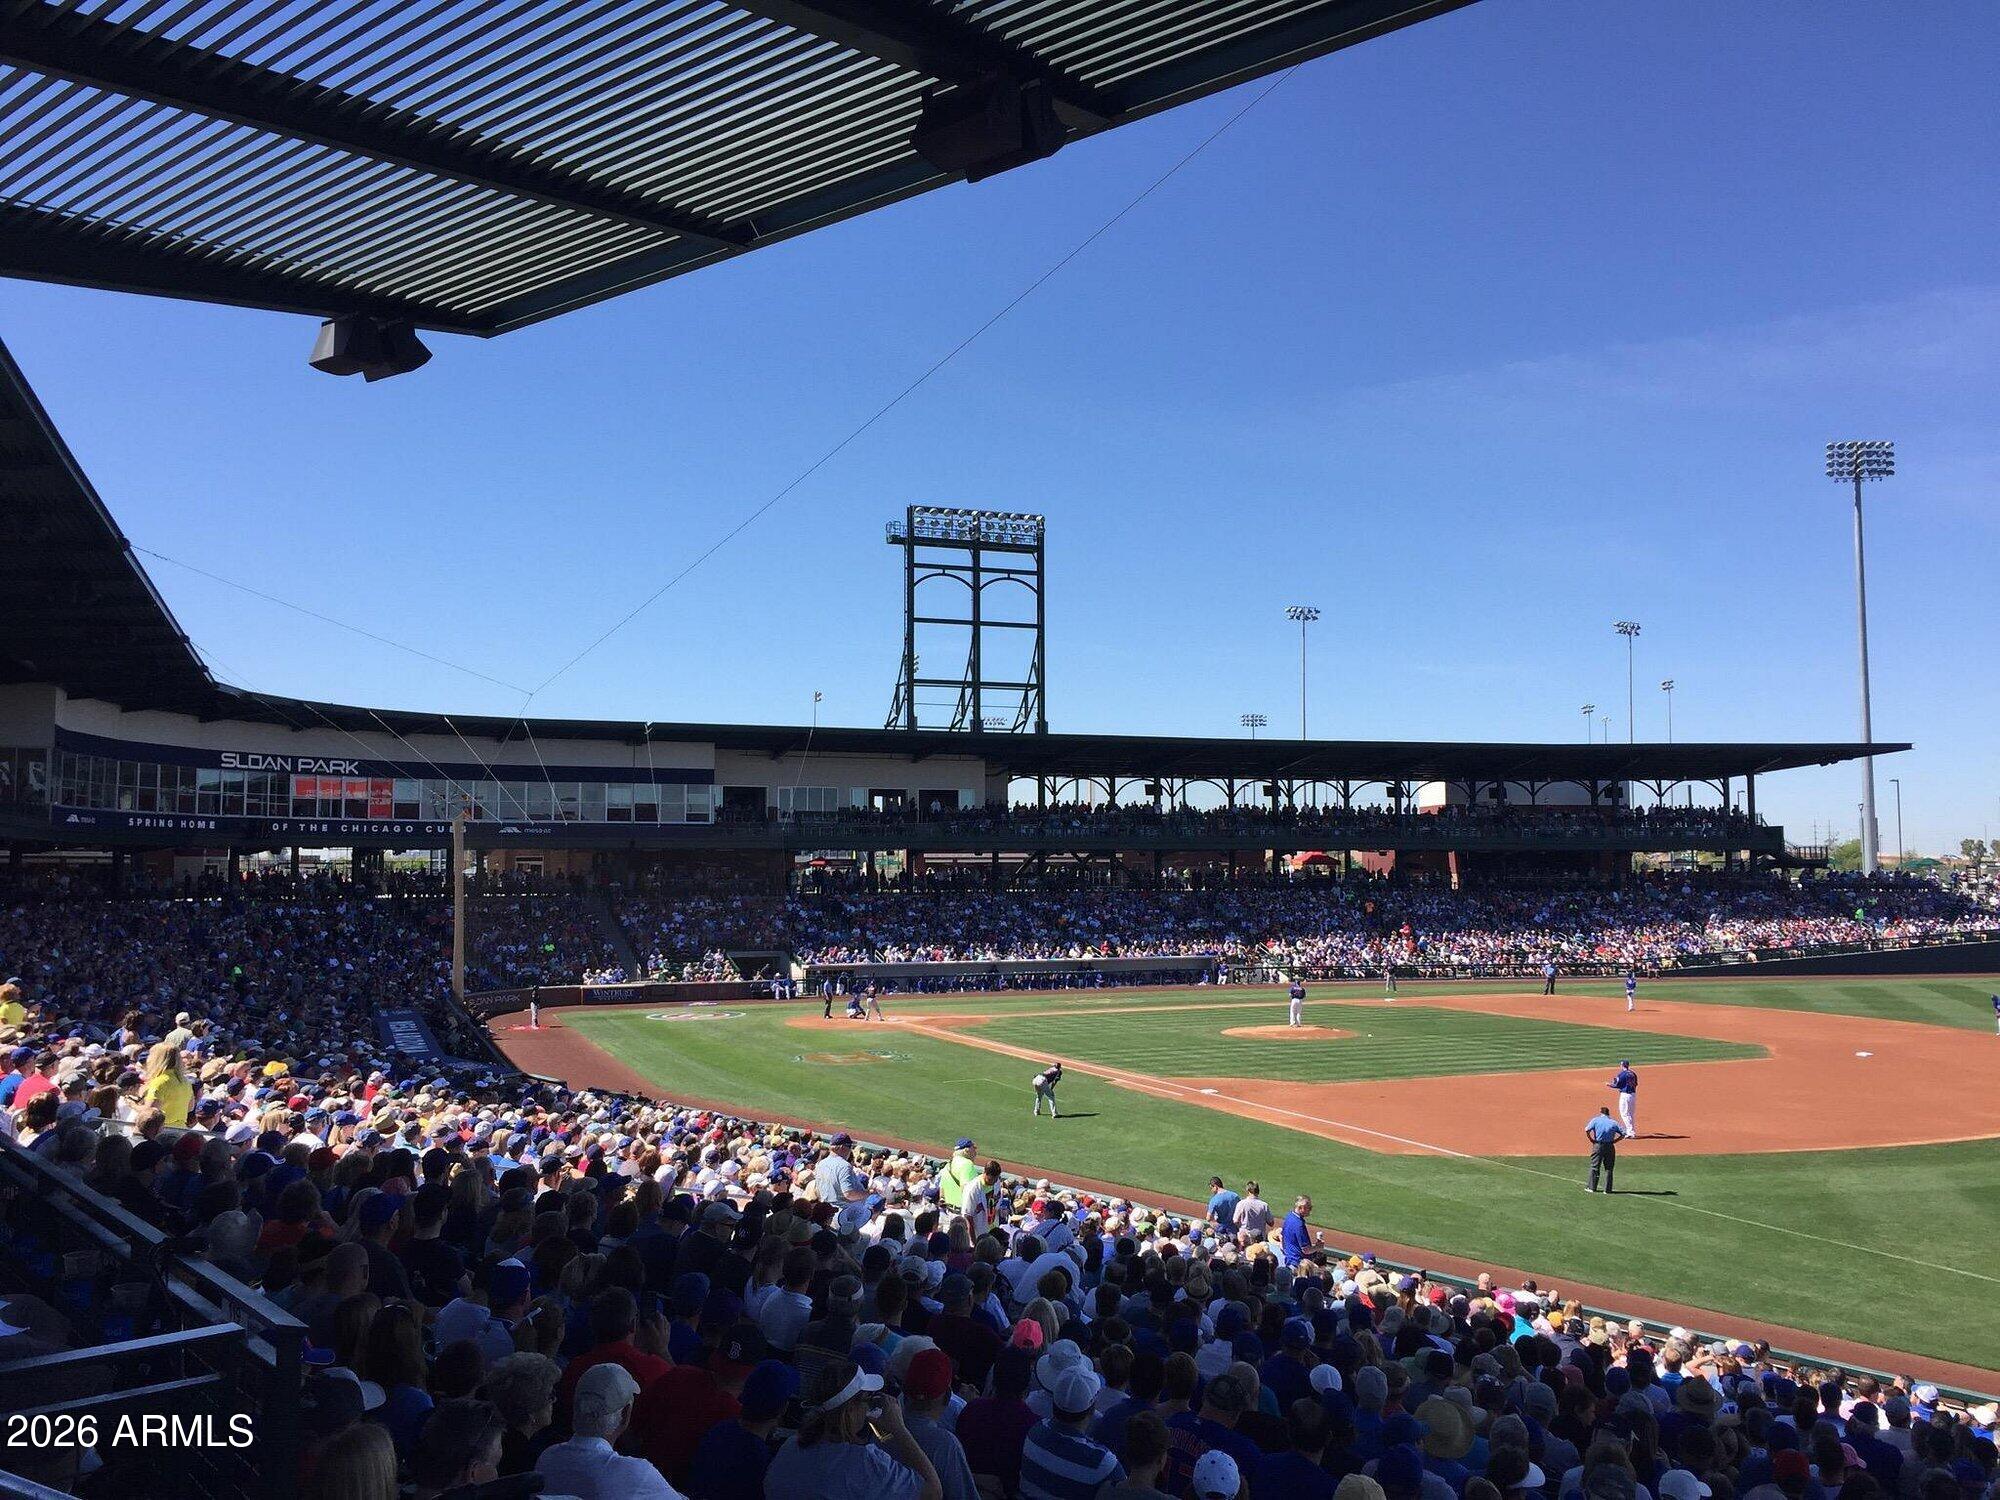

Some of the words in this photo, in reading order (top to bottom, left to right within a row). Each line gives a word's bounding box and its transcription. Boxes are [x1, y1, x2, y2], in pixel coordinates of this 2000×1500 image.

[220, 752, 292, 771] SLOAN
[297, 757, 359, 775] PARK
[128, 817, 174, 828] SPRING
[180, 820, 216, 829] HOME
[272, 823, 289, 831] OF
[299, 823, 328, 832] THE
[340, 824, 414, 833] CHICAGO
